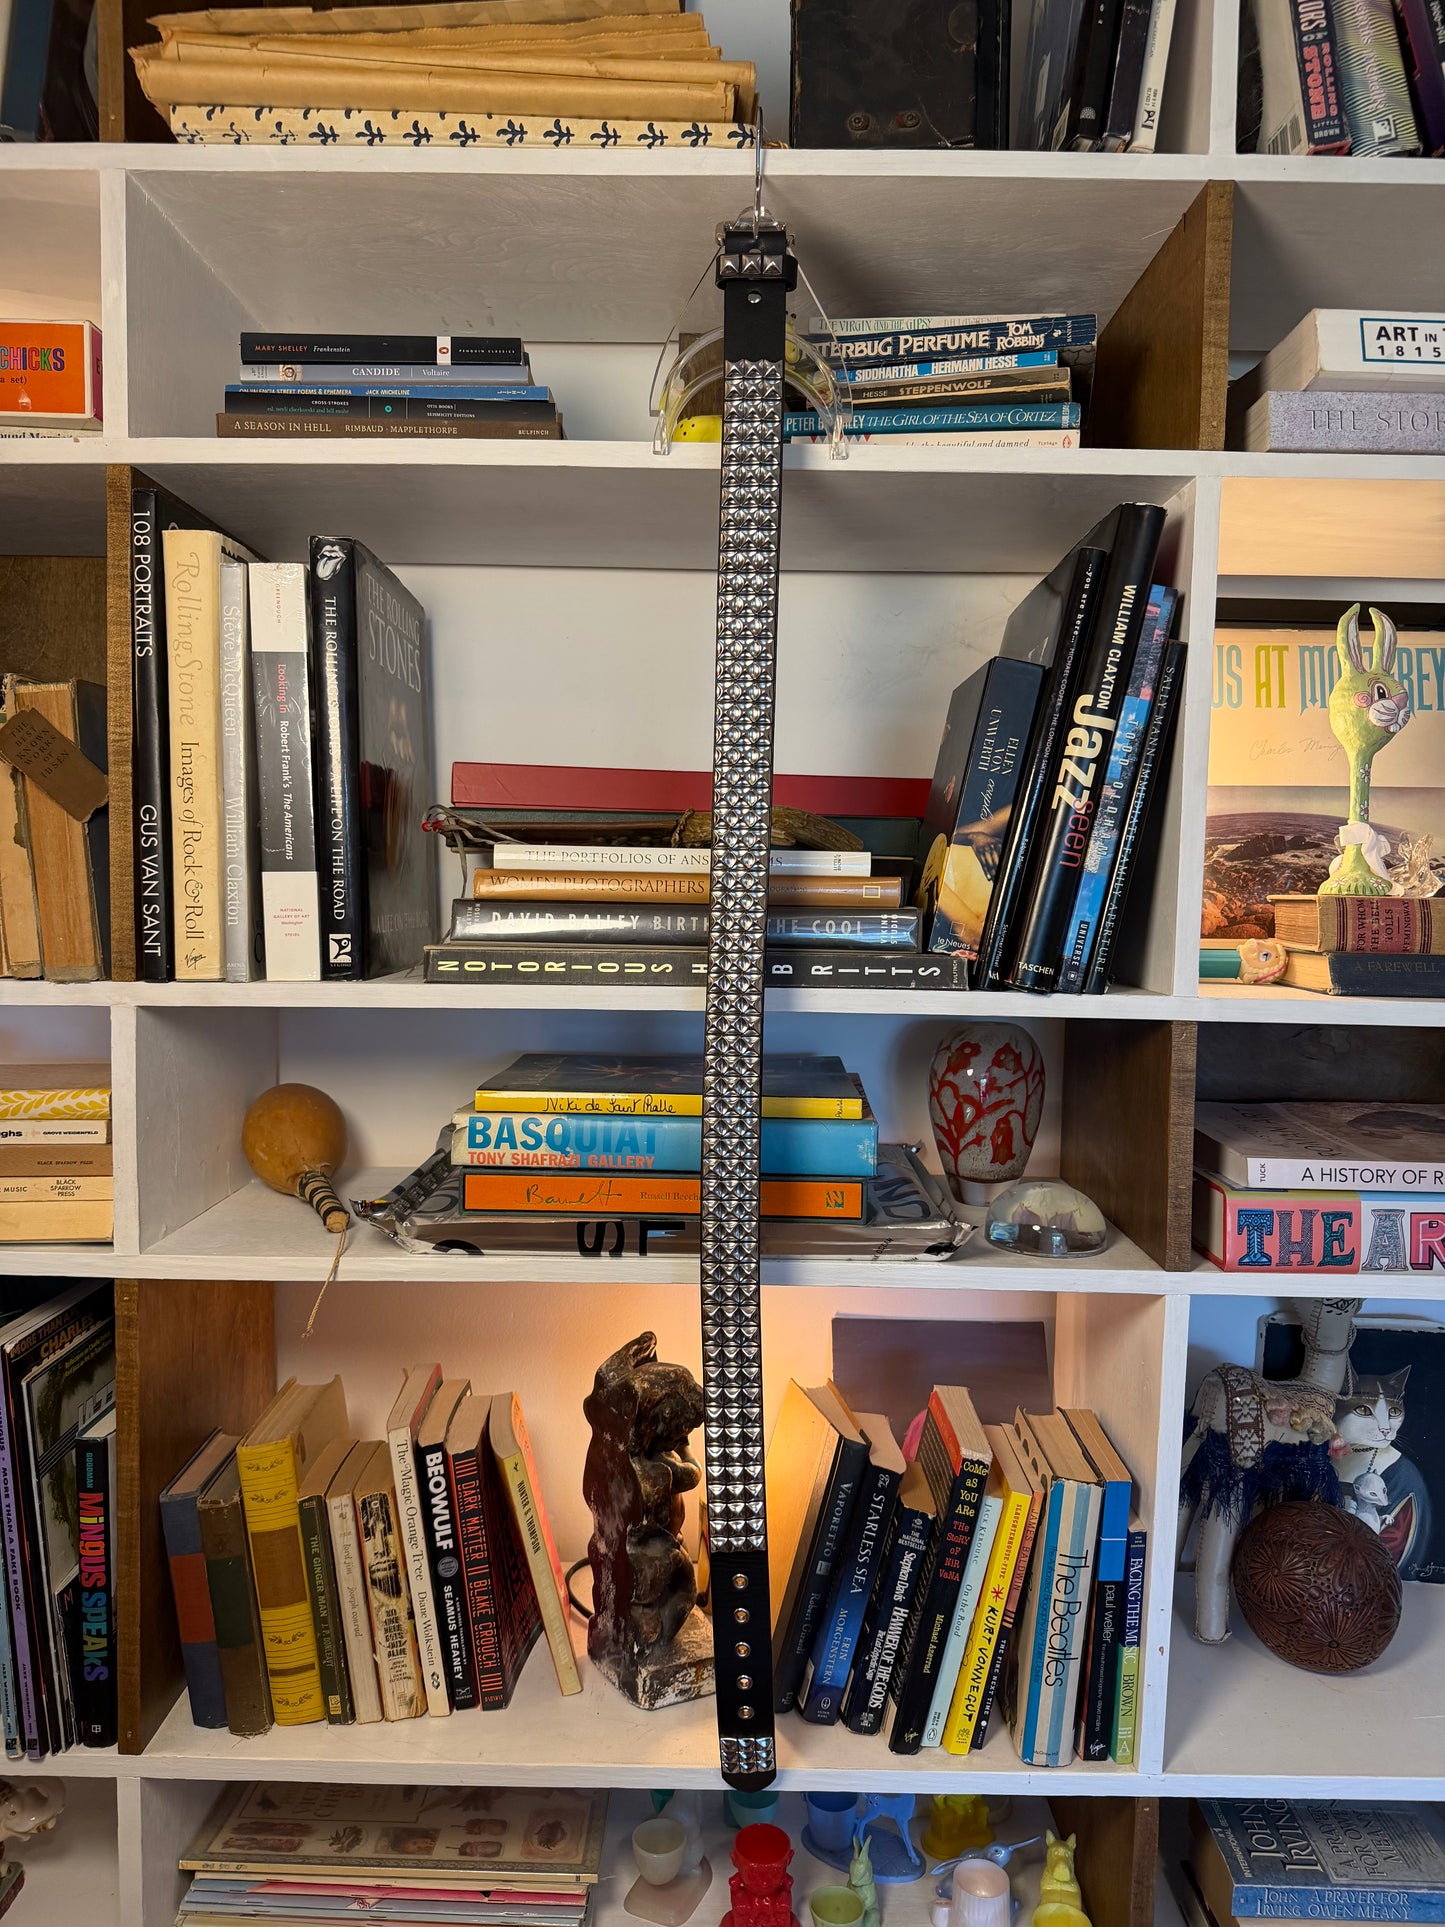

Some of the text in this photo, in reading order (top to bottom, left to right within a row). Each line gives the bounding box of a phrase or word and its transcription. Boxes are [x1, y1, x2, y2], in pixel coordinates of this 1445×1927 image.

[1302, 45, 1326, 120] STONE
[1321, 42, 1338, 117] ROLLING
[898, 329, 991, 356] PERFUME
[996, 331, 1046, 351] ROBBINS
[1005, 321, 1033, 336] TOM
[1376, 326, 1438, 343] ART IN
[0, 346, 64, 371] CHICKS
[254, 344, 351, 353] MARY SHELLEY Frankenstein
[352, 367, 450, 376] CANDIDE Voltaire
[855, 355, 1018, 382] SIDDHARTHA HERMANN HESSE
[899, 379, 991, 397] STEPPENWOLF
[234, 421, 240, 430] A
[244, 421, 284, 431] SEASON
[289, 423, 300, 431] IN
[304, 423, 331, 432] HELL
[345, 424, 384, 432] RIMBAUD
[390, 425, 458, 434] MAPPLETHORPE
[786, 408, 1056, 433] PETER THE GIRL OF THE SEA OF CORTEZ
[1306, 409, 1363, 431] THE
[134, 510, 153, 658] 108 PORTRAITS
[365, 572, 420, 646] THE ROLLING
[368, 608, 421, 693] STONES
[1096, 585, 1138, 709] WILLIAM CLAXTON
[1255, 645, 1289, 709] AT
[978, 706, 1002, 771] UNWERTH
[1002, 737, 1019, 777] ELLEN
[1051, 694, 1118, 811] Jazz
[223, 605, 246, 925] Steve McQueen William Claxton
[277, 663, 294, 861] Looking Robert Frank's The Americans
[1099, 720, 1139, 857] TODD OLDHAM
[1059, 796, 1093, 868] seen
[1095, 666, 1175, 974] SALLY MANN IMMEDIATE FAMILY APERTURE
[526, 851, 709, 866] THE PORTFOLIOS OF ANS
[140, 804, 161, 957] GUS VAN SANT
[490, 876, 705, 894] WOMEN PHOTOGRAPHERS
[492, 912, 554, 927] DAVID
[569, 914, 639, 930] BAILEY
[812, 920, 863, 935] COOL
[881, 914, 889, 944] VIKING
[1357, 899, 1366, 950] FOR WHOM
[1385, 908, 1394, 942] TOLLS
[1402, 900, 1411, 952] HEMINGWAY
[1071, 923, 1089, 966] UNIVERSE
[438, 960, 941, 977] NOTORIOUS RITTS
[1018, 961, 1055, 976] TASCHEN
[1355, 962, 1440, 973] A FAREWELL
[467, 1116, 664, 1156] BASQUIAT
[468, 1151, 655, 1169] TONY SHAFRAZI GALLERY
[1259, 1163, 1267, 1182] TUCK
[1301, 1167, 1314, 1182] A
[1320, 1168, 1397, 1184] HISTORY
[1402, 1169, 1428, 1185] OF
[1, 1467, 9, 1500] MORE
[85, 1452, 94, 1489] GOODMAN
[6, 1503, 15, 1529] THAN
[425, 1451, 453, 1550] BEOWULF
[396, 1440, 436, 1667] The Magic Orange Tree Diane Wolkstein
[850, 1493, 885, 1594] STARLESS SEA
[898, 1539, 927, 1550] BESTSELLER
[901, 1534, 925, 1544] NATIONAL
[999, 1503, 1023, 1580] SLAUGHTERHOUSE-FIVE
[1012, 1508, 1040, 1591] JAMES BALDWIN
[10, 1548, 18, 1575] FAKE
[1127, 1558, 1143, 1600] FACING
[13, 1579, 21, 1611] BOOK
[443, 1584, 456, 1632] SEAMUS
[1103, 1584, 1116, 1643] paul weller
[1044, 1549, 1090, 1688] The Beatles
[1126, 1601, 1141, 1630] THE
[449, 1634, 463, 1681] HEANEY
[822, 1608, 849, 1685] MORGENSTERN
[839, 1636, 852, 1660] ERIN
[923, 1613, 945, 1675] Michael Azerrad
[1123, 1630, 1140, 1664] MUSIC
[963, 1604, 1000, 1723] KURT VONNEGUT
[1120, 1674, 1135, 1717] BROWN
[1235, 1803, 1290, 1861] JOHN
[1264, 1800, 1324, 1872] IRVING
[1256, 1899, 1300, 1917] IRVING
[1264, 1888, 1300, 1903] JOHN
[1308, 1903, 1410, 1920] OWEN MEANY
[1312, 1889, 1409, 1905] A PRAYER FOR
